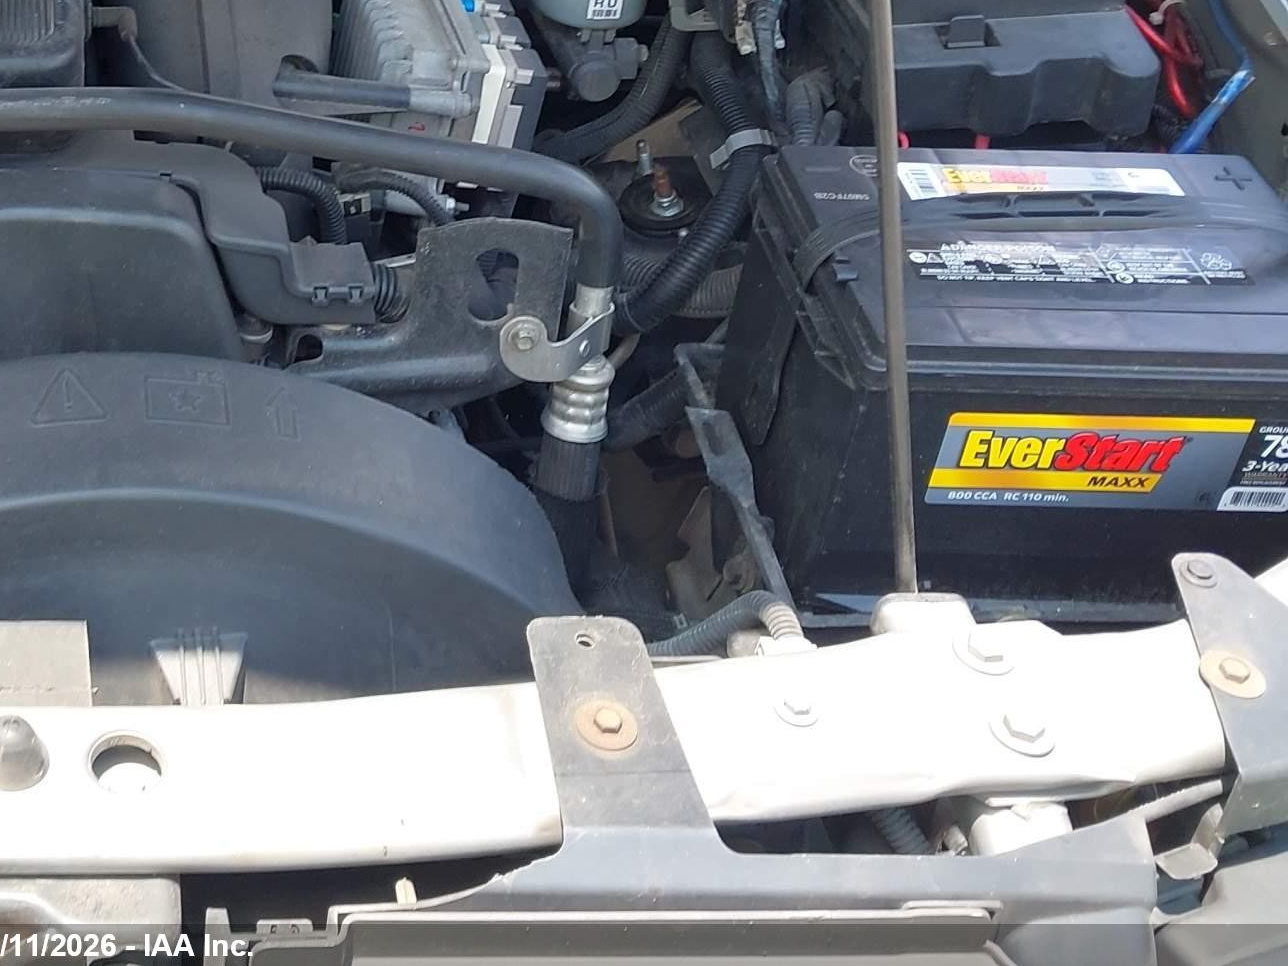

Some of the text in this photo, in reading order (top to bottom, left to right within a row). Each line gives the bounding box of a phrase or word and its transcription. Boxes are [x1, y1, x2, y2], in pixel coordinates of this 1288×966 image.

[959, 430, 1186, 472] EverStart
[1087, 475, 1150, 488] MAXX
[947, 490, 1069, 502] 800 CCA RC 110 min.
